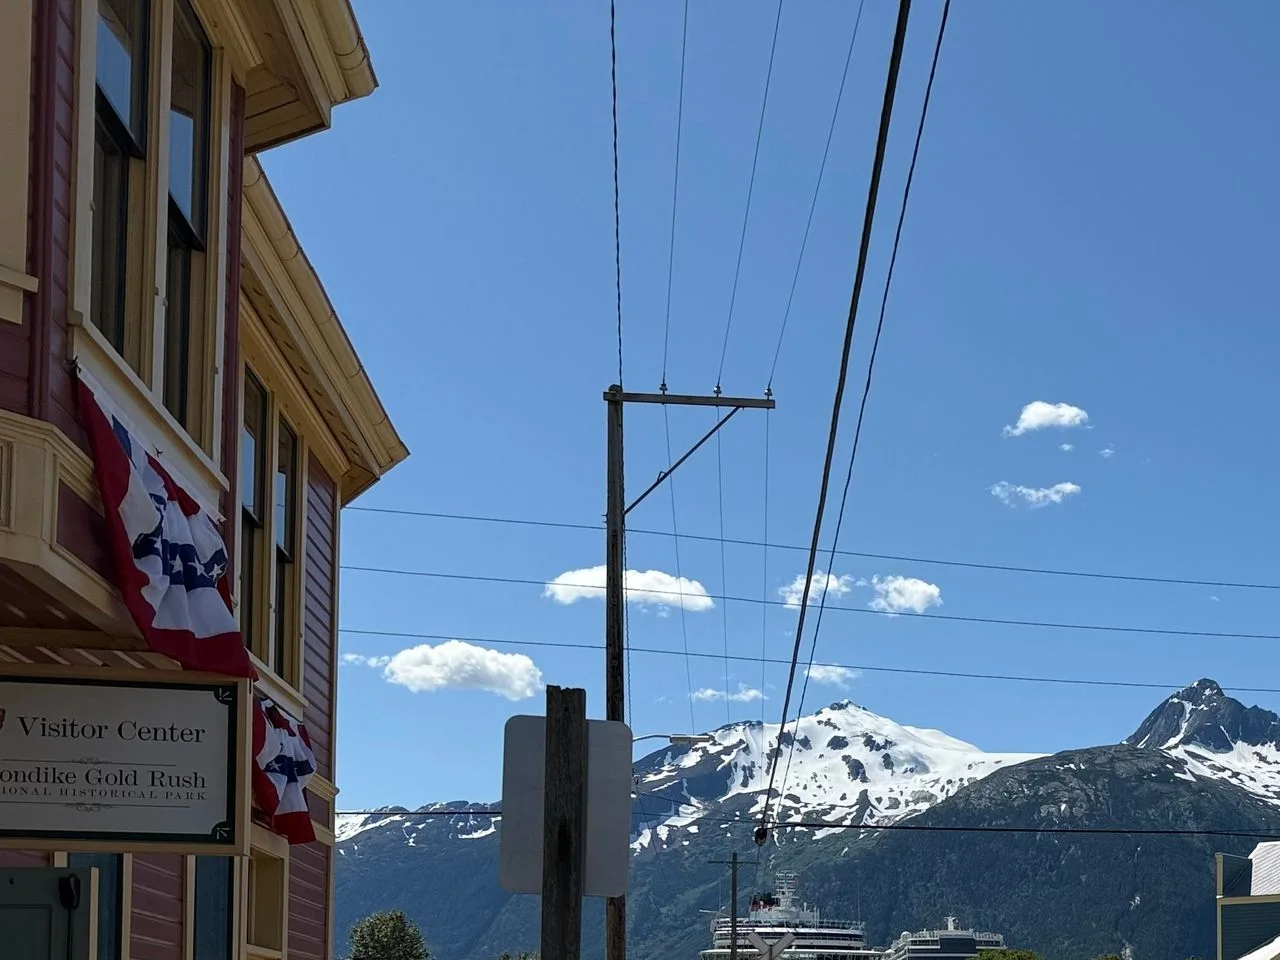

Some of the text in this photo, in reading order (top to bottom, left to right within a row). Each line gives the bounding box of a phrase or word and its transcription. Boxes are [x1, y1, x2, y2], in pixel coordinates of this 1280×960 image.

[16, 716, 206, 743] Visitor Center
[85, 768, 139, 786] Gold
[148, 770, 207, 788] Rush
[59, 788, 157, 799] HISTORICAL
[165, 791, 207, 800] PARK
